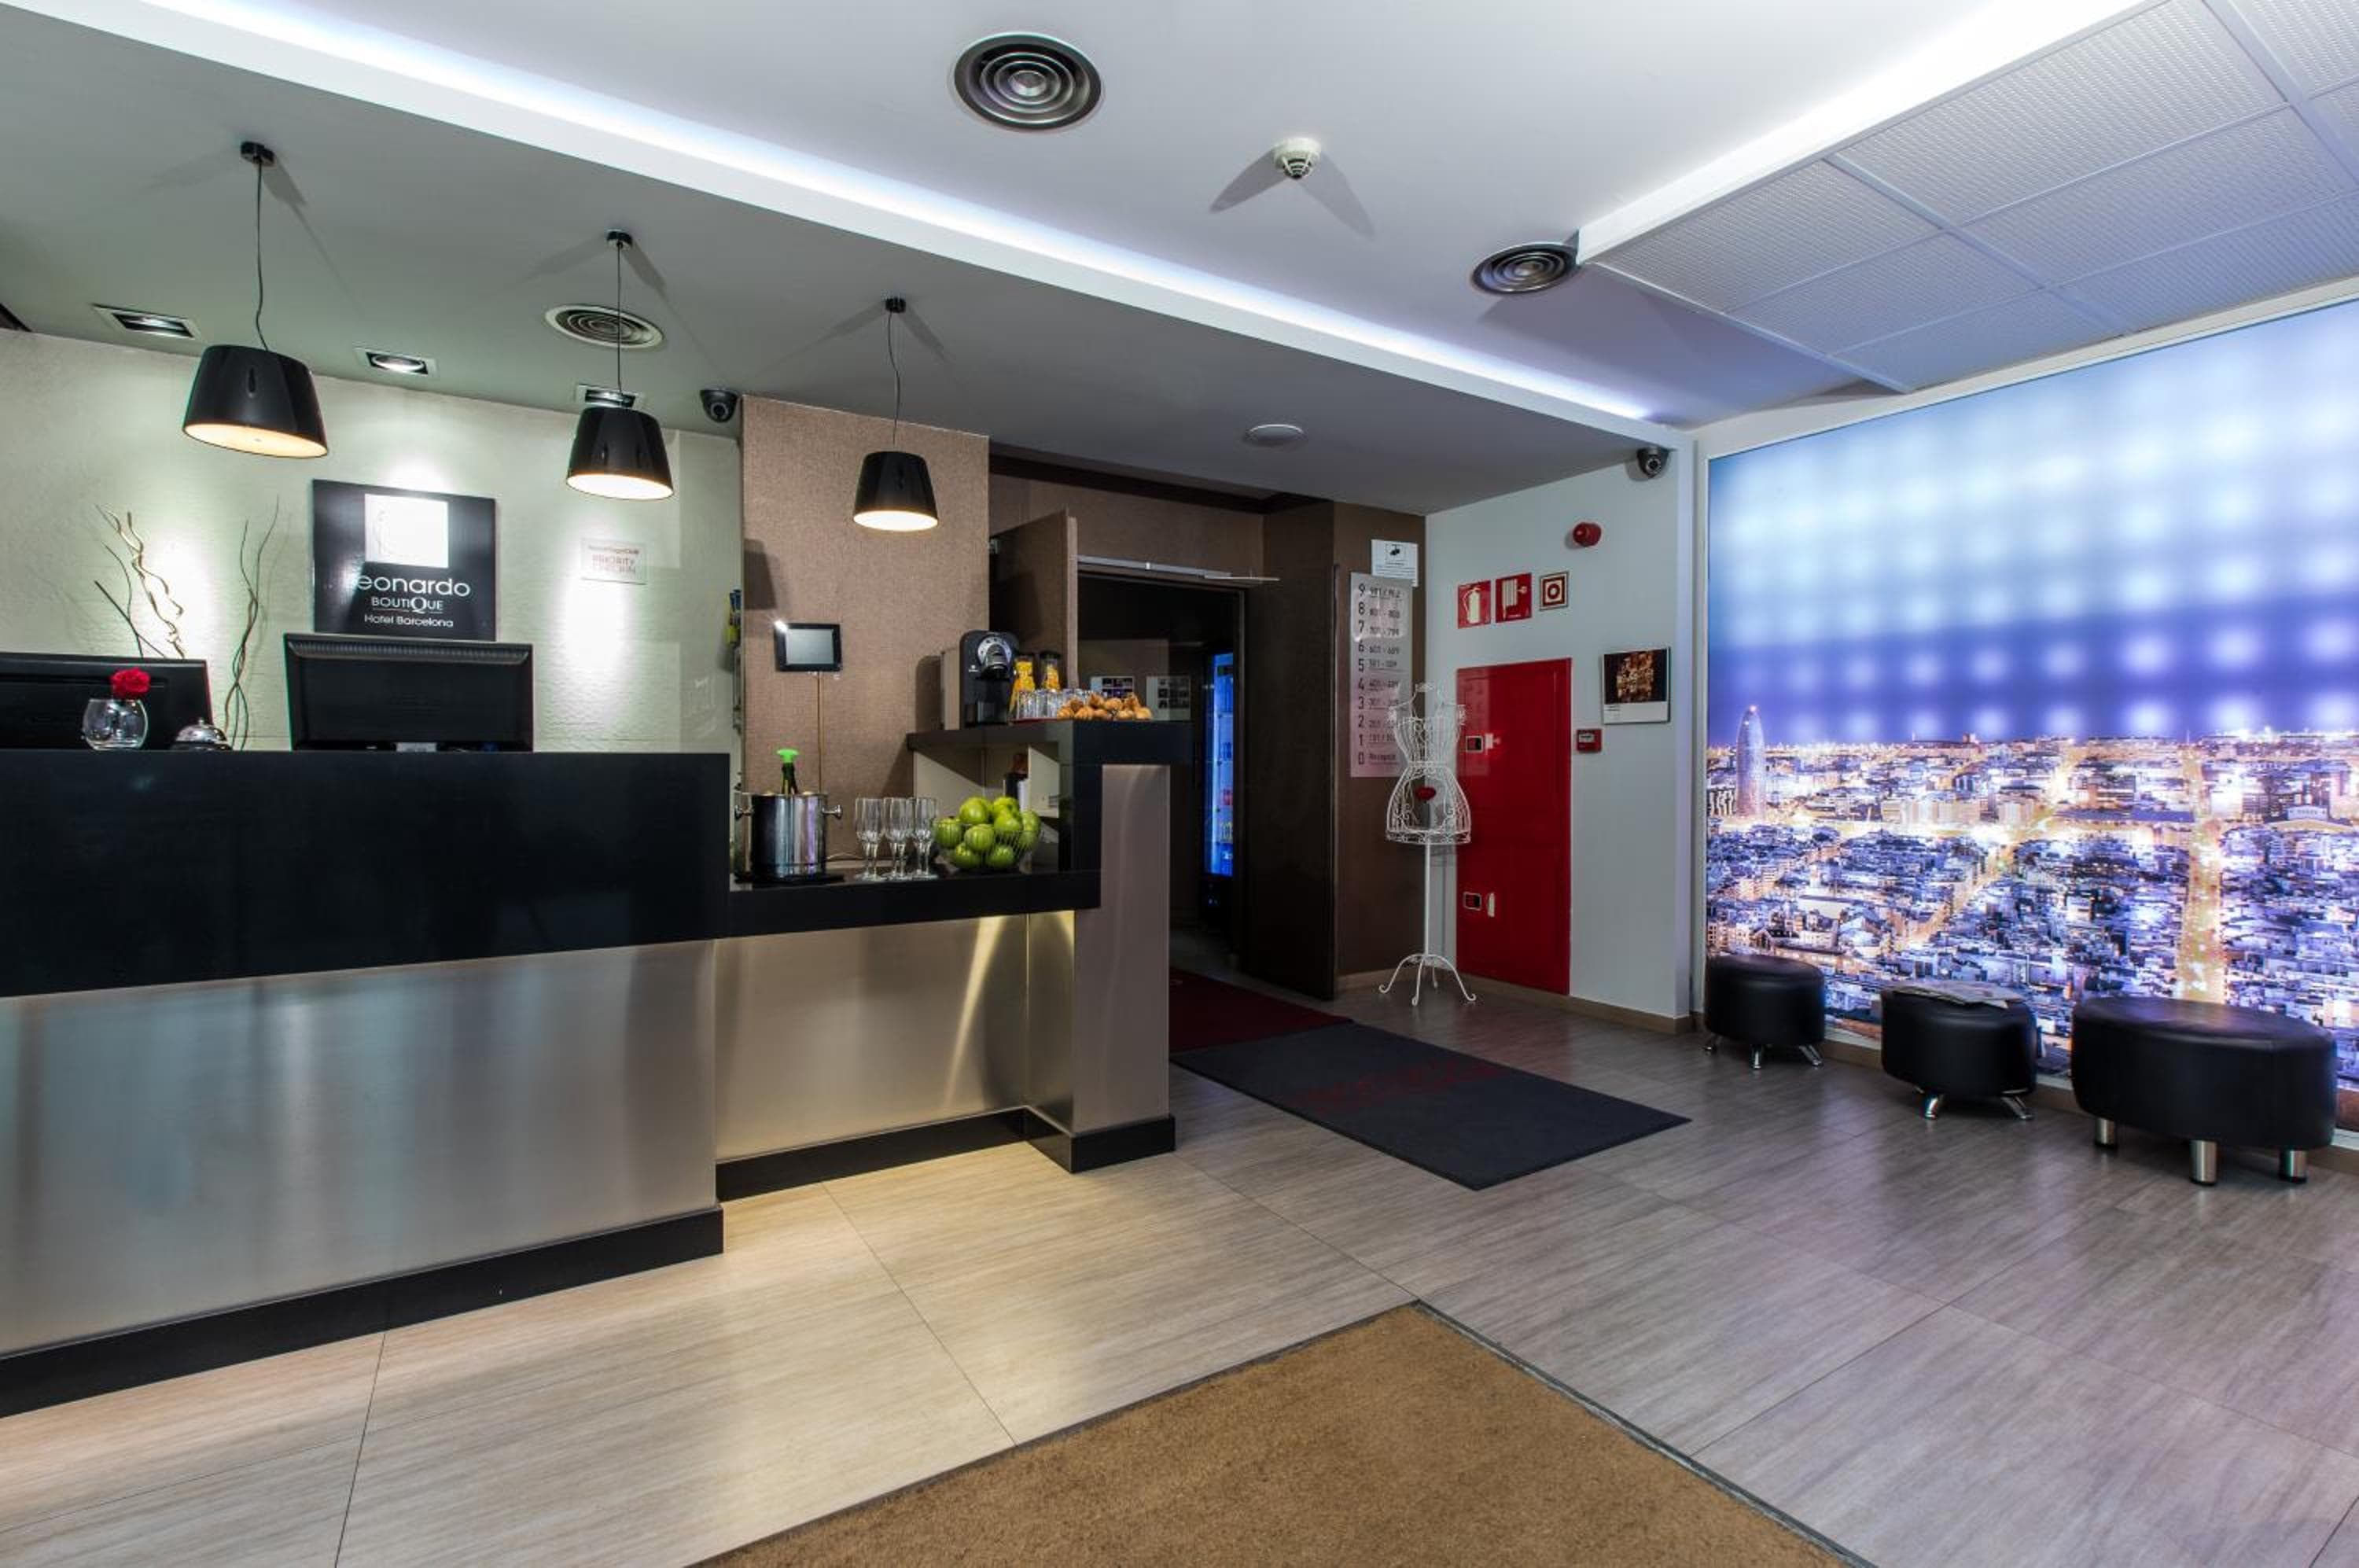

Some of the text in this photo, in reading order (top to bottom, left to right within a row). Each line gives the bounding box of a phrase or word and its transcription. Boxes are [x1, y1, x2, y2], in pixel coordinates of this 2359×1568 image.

[353, 572, 471, 597] eonardo
[1358, 583, 1366, 596] 9
[1358, 601, 1366, 615] 8
[364, 613, 454, 628] Hotel Barcelona
[1358, 619, 1365, 633] 7
[1358, 639, 1364, 652] 6
[1358, 658, 1364, 672] 5
[1358, 678, 1364, 690] 4
[1358, 696, 1364, 709] 3
[1358, 715, 1365, 728] 2
[1359, 734, 1364, 745] 1
[1358, 752, 1365, 765] 0
